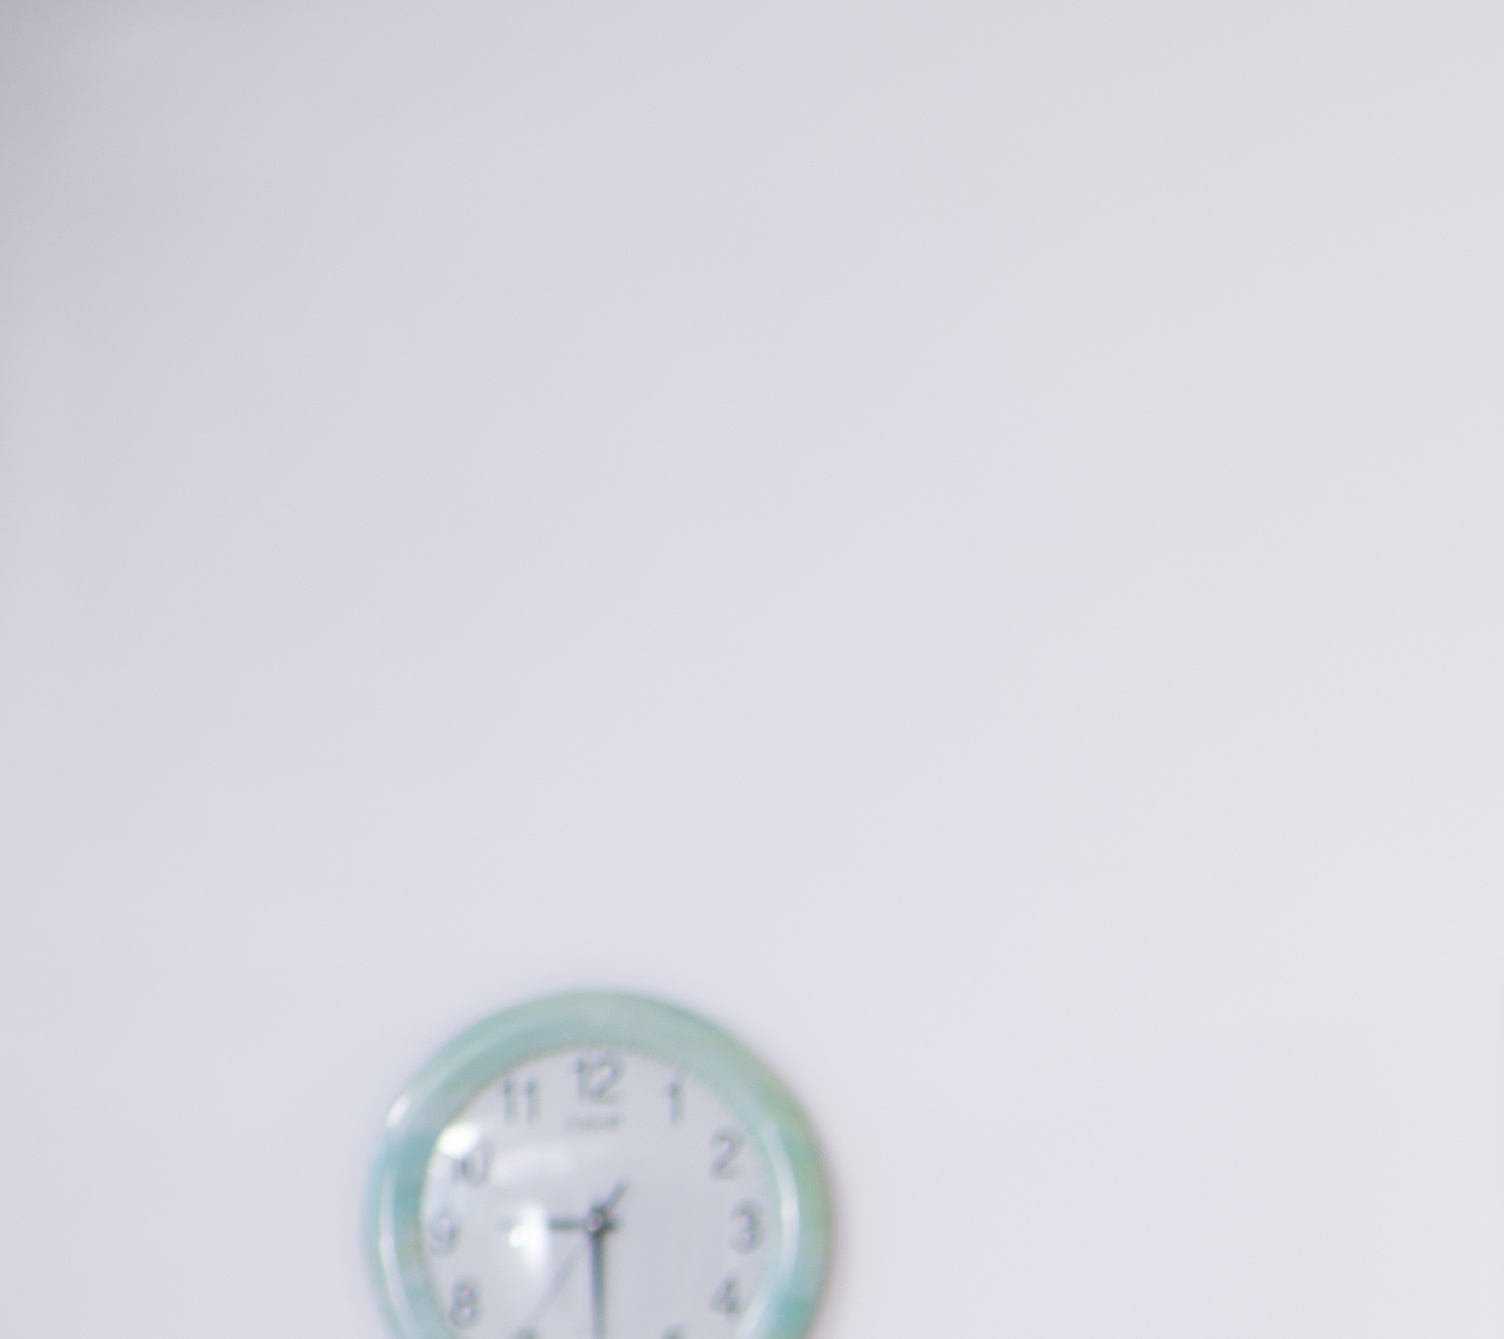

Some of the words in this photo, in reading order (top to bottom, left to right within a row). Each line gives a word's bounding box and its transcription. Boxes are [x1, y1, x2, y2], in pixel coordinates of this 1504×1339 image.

[502, 1077, 540, 1126] 11
[573, 1055, 622, 1103] 12
[665, 1077, 684, 1127] 1
[710, 1128, 743, 1179] 2
[428, 1202, 461, 1257] 9
[731, 1201, 763, 1254] 3
[448, 1277, 482, 1329] 8
[710, 1275, 742, 1318] 4
